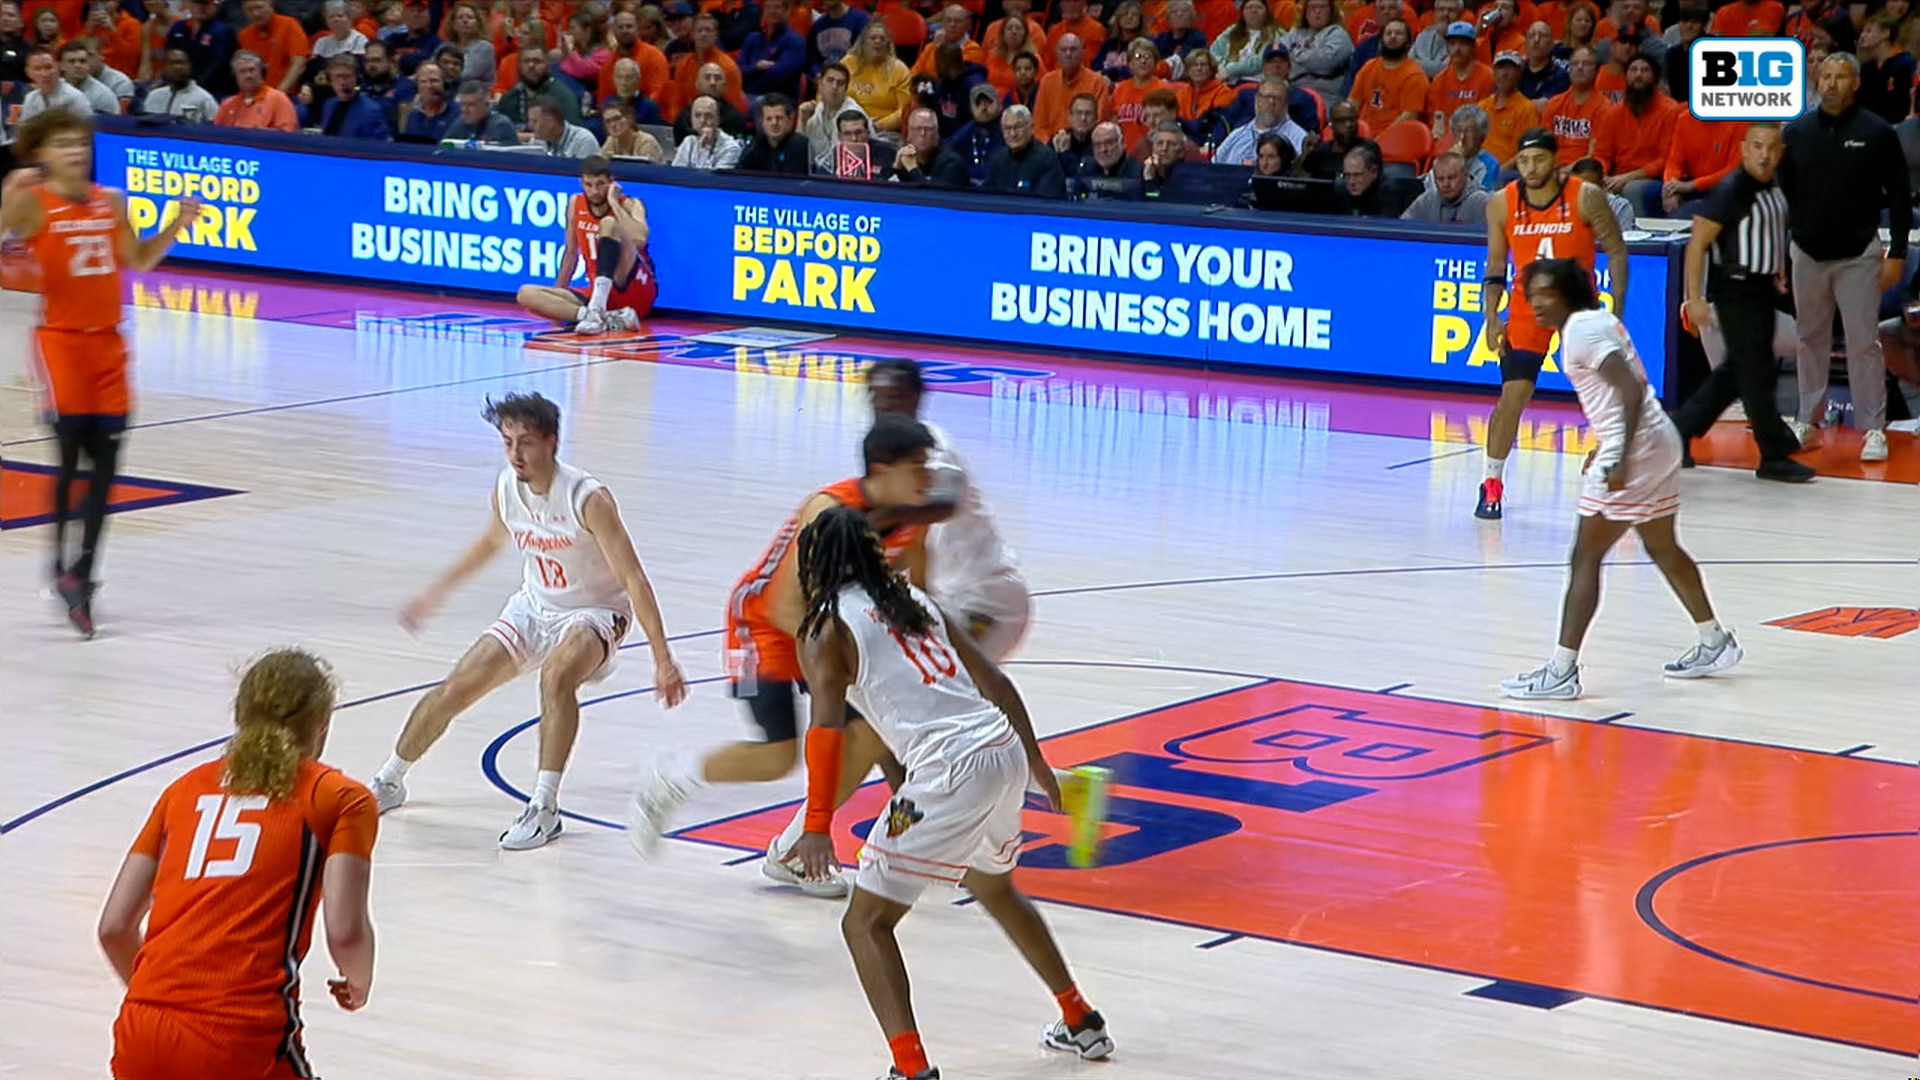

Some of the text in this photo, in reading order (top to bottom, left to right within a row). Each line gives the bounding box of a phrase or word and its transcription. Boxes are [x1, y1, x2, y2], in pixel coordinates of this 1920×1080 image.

[125, 148, 260, 176] THE VILLAGE OF
[126, 166, 260, 204] BEDFORD
[384, 176, 498, 222] BRING
[734, 206, 881, 233] THE VILLAGE OF
[1513, 222, 1573, 235] ILLINOIS
[352, 222, 523, 275] BUSINESS
[733, 224, 881, 263] BEDFORD
[1031, 232, 1293, 291] BRING YOUR
[732, 256, 877, 313] PARK
[1435, 258, 1476, 279] THE
[991, 282, 1332, 350] BUSINESS HOME
[535, 555, 567, 588] 13
[888, 626, 957, 685] 10
[184, 794, 270, 880] 15
